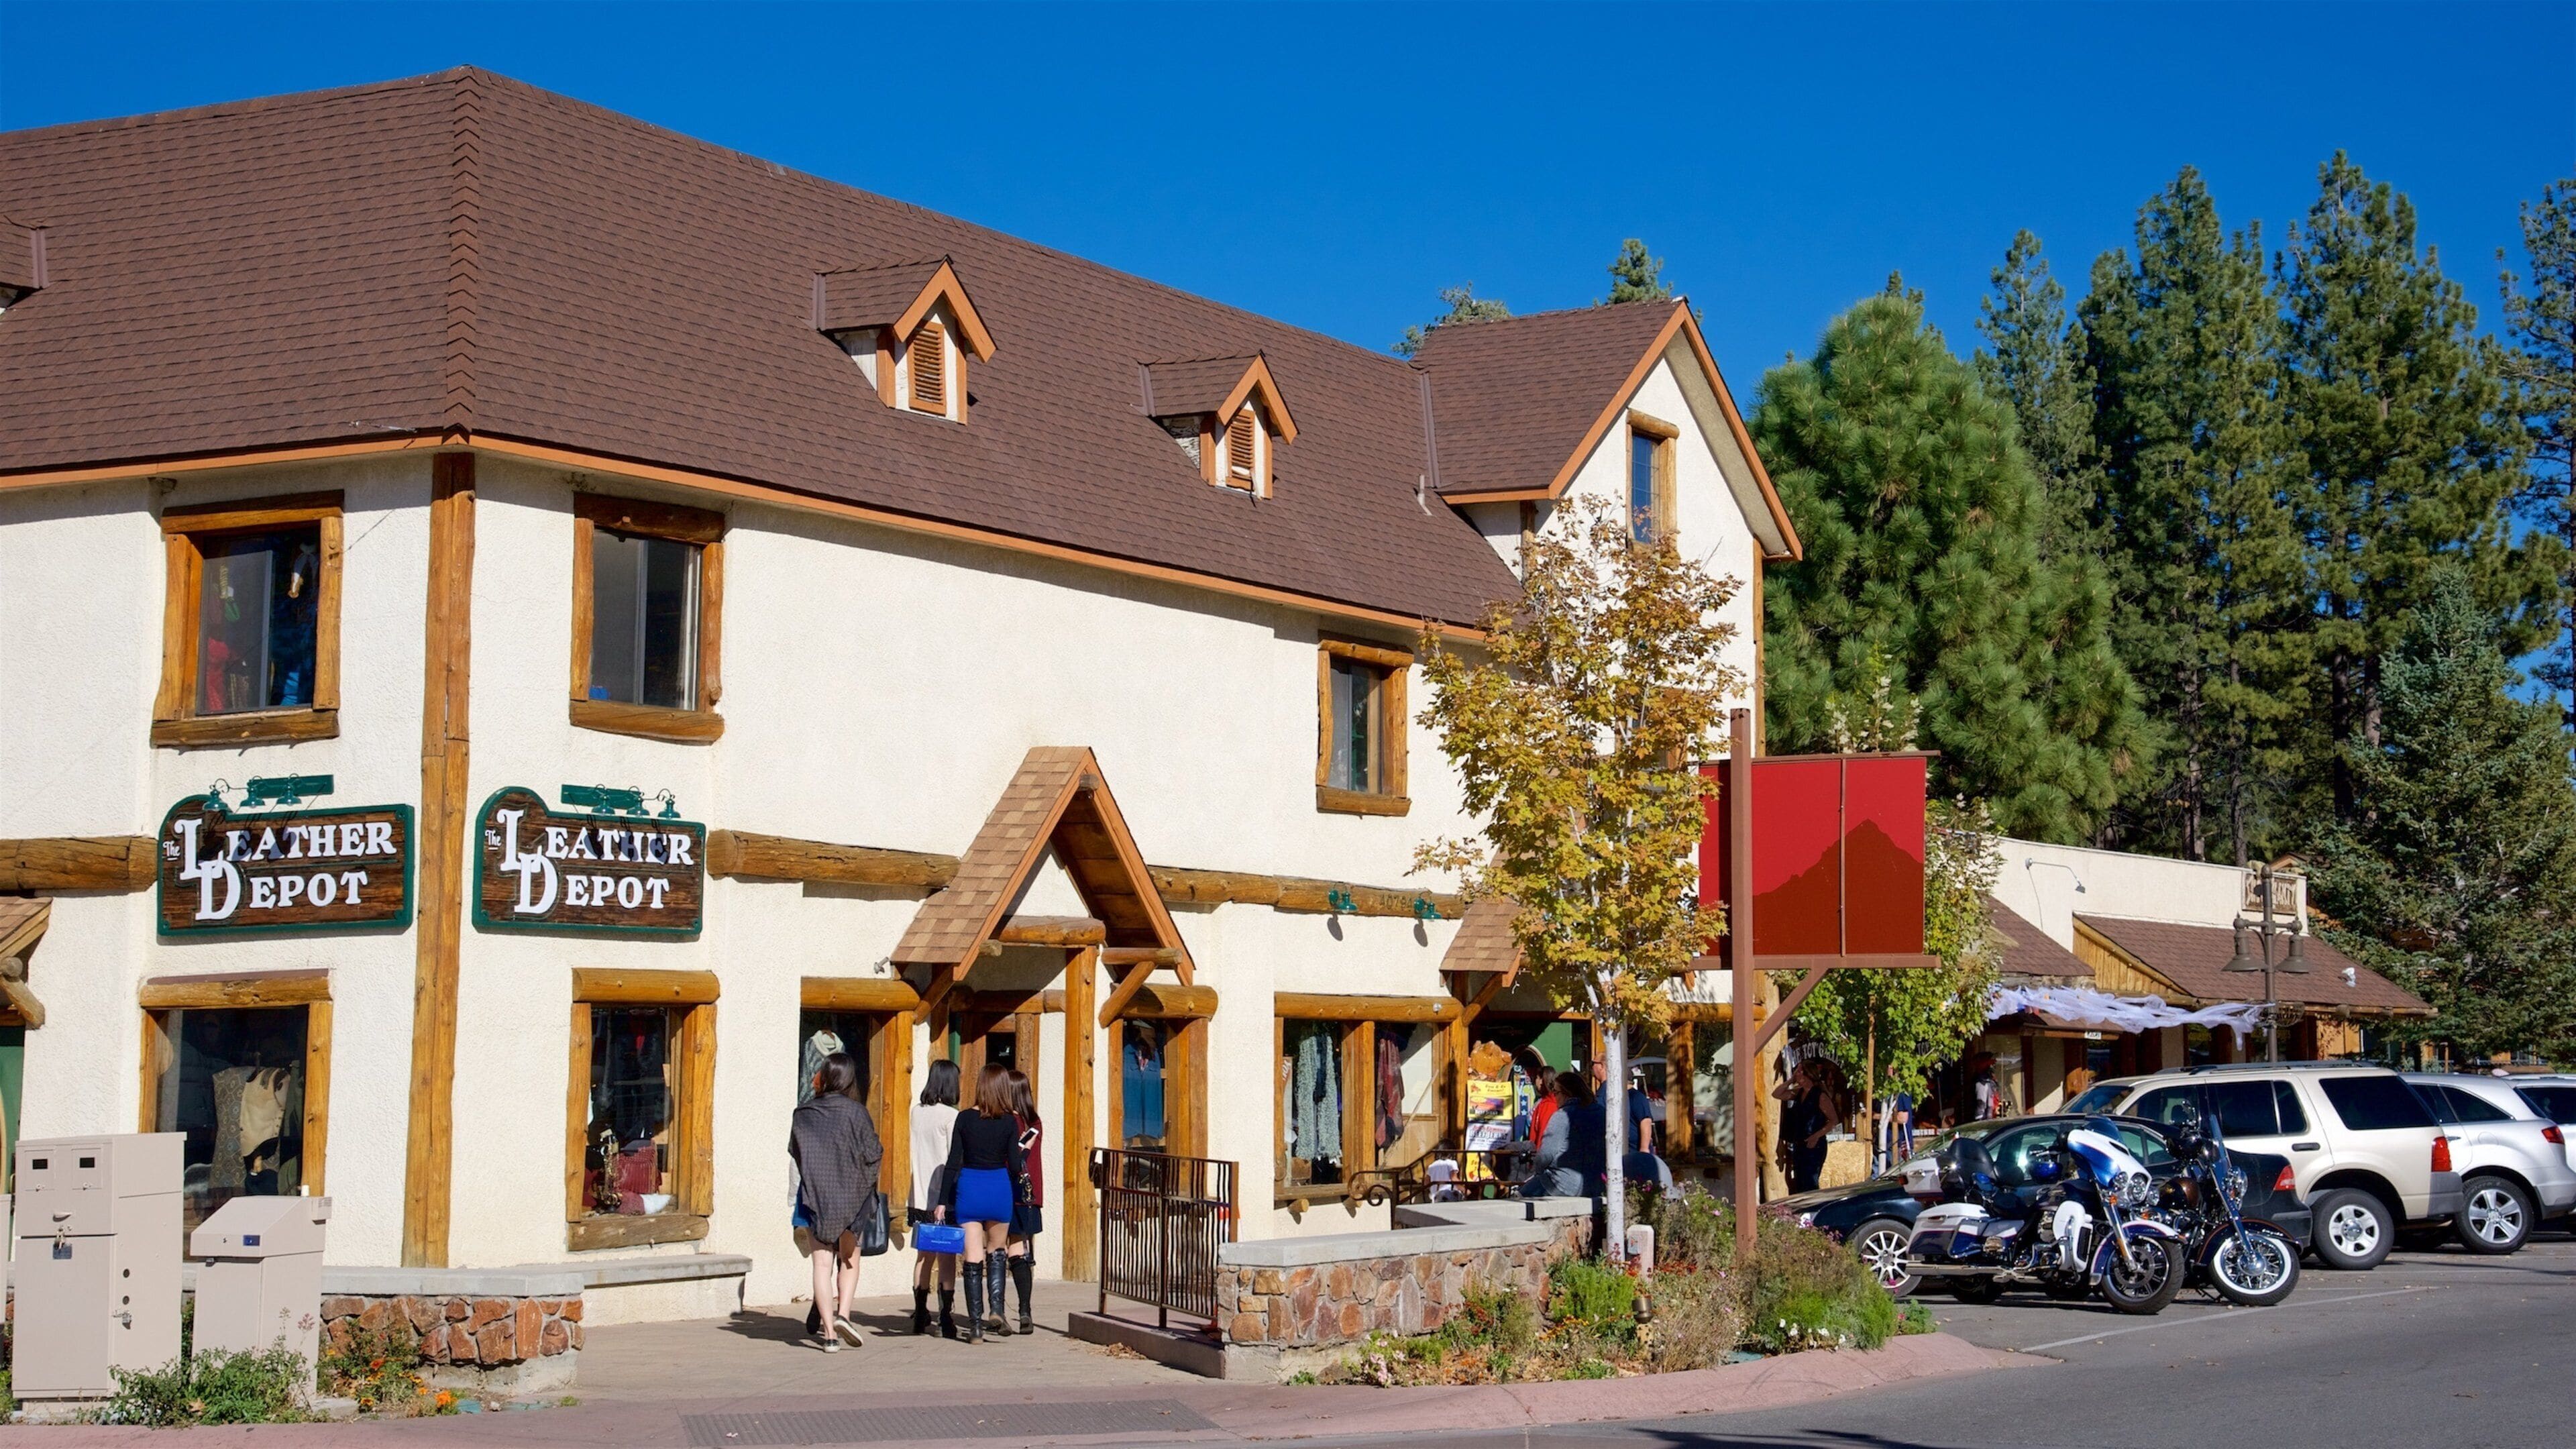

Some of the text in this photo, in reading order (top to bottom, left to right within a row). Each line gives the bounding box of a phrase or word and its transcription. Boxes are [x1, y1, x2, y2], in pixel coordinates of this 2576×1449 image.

[163, 818, 397, 880] The LEATHER
[485, 809, 695, 871] The LEATHER
[195, 859, 368, 920] DEPOT
[514, 852, 670, 914] DEPOT
[1802, 1042, 1818, 1059] TOY
